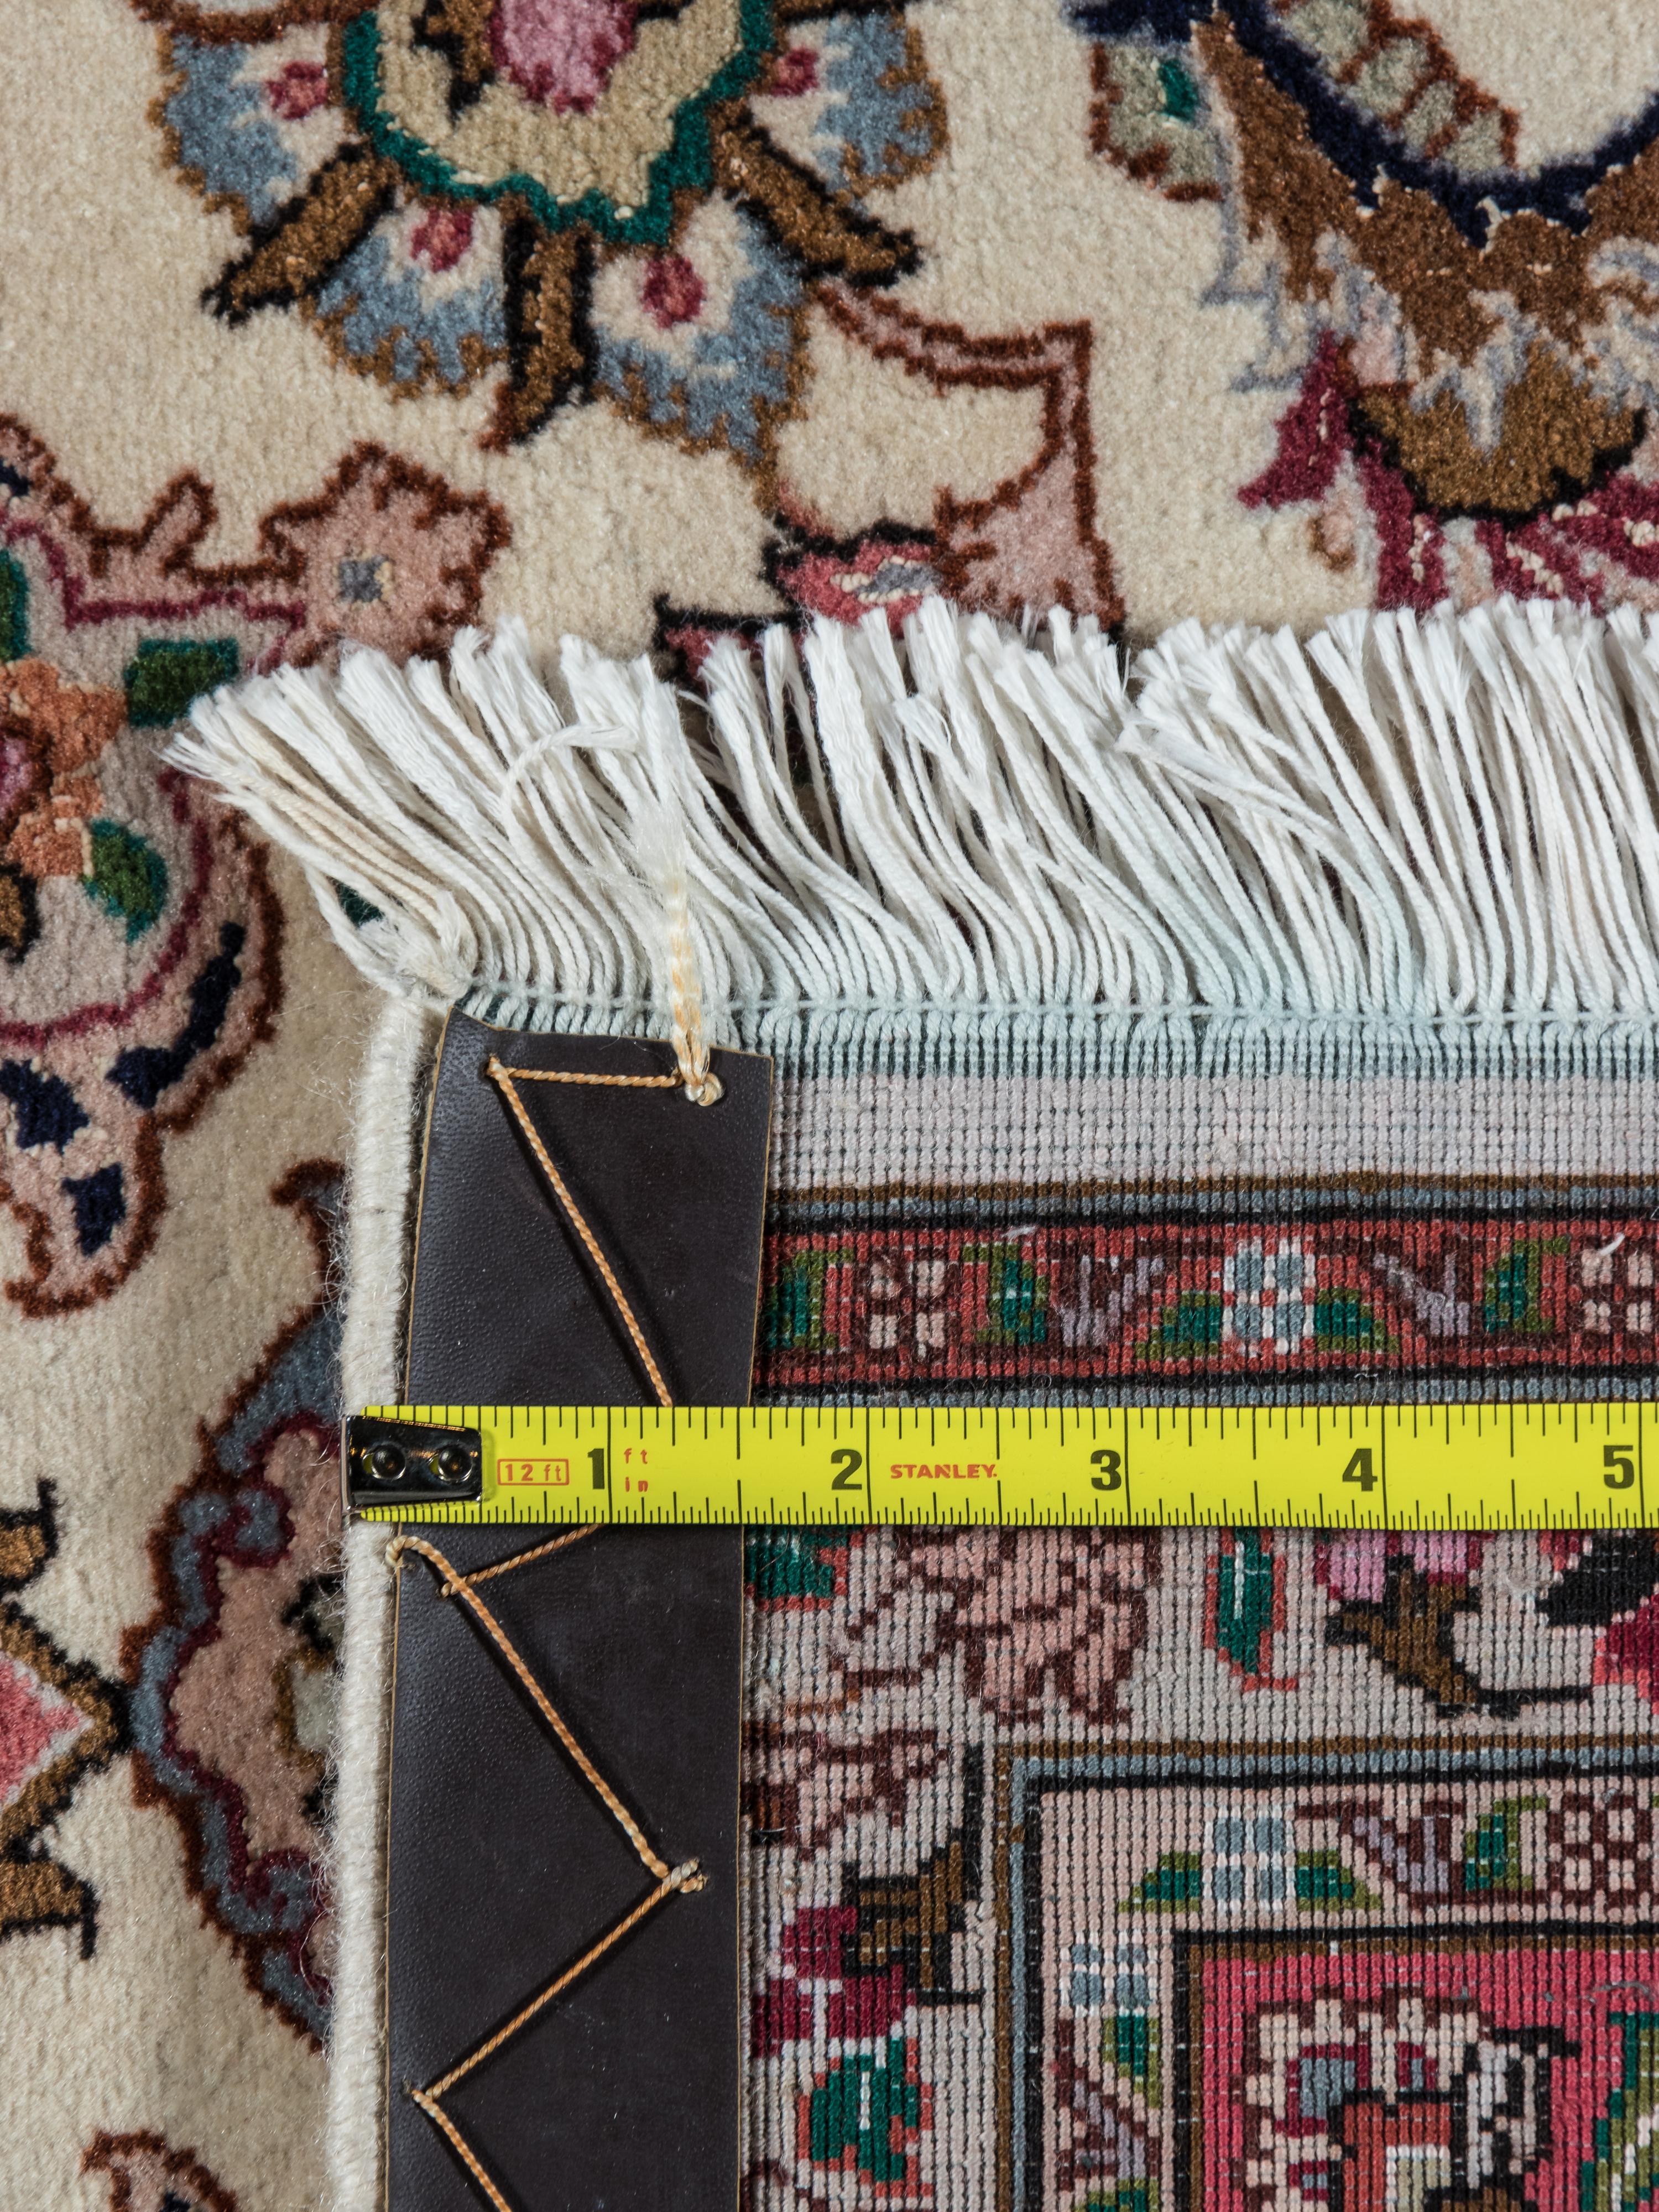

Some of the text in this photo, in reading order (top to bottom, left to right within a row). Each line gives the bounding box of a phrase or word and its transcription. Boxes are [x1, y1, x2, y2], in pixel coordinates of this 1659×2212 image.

[505, 1464, 562, 1481] 12 ft
[587, 1448, 605, 1489] 1
[624, 1448, 648, 1464] ft
[831, 1449, 863, 1490] 2
[1090, 1449, 1122, 1491] 3
[1342, 1448, 1378, 1491] 4
[1603, 1445, 1635, 1489] 5
[625, 1478, 648, 1492] in
